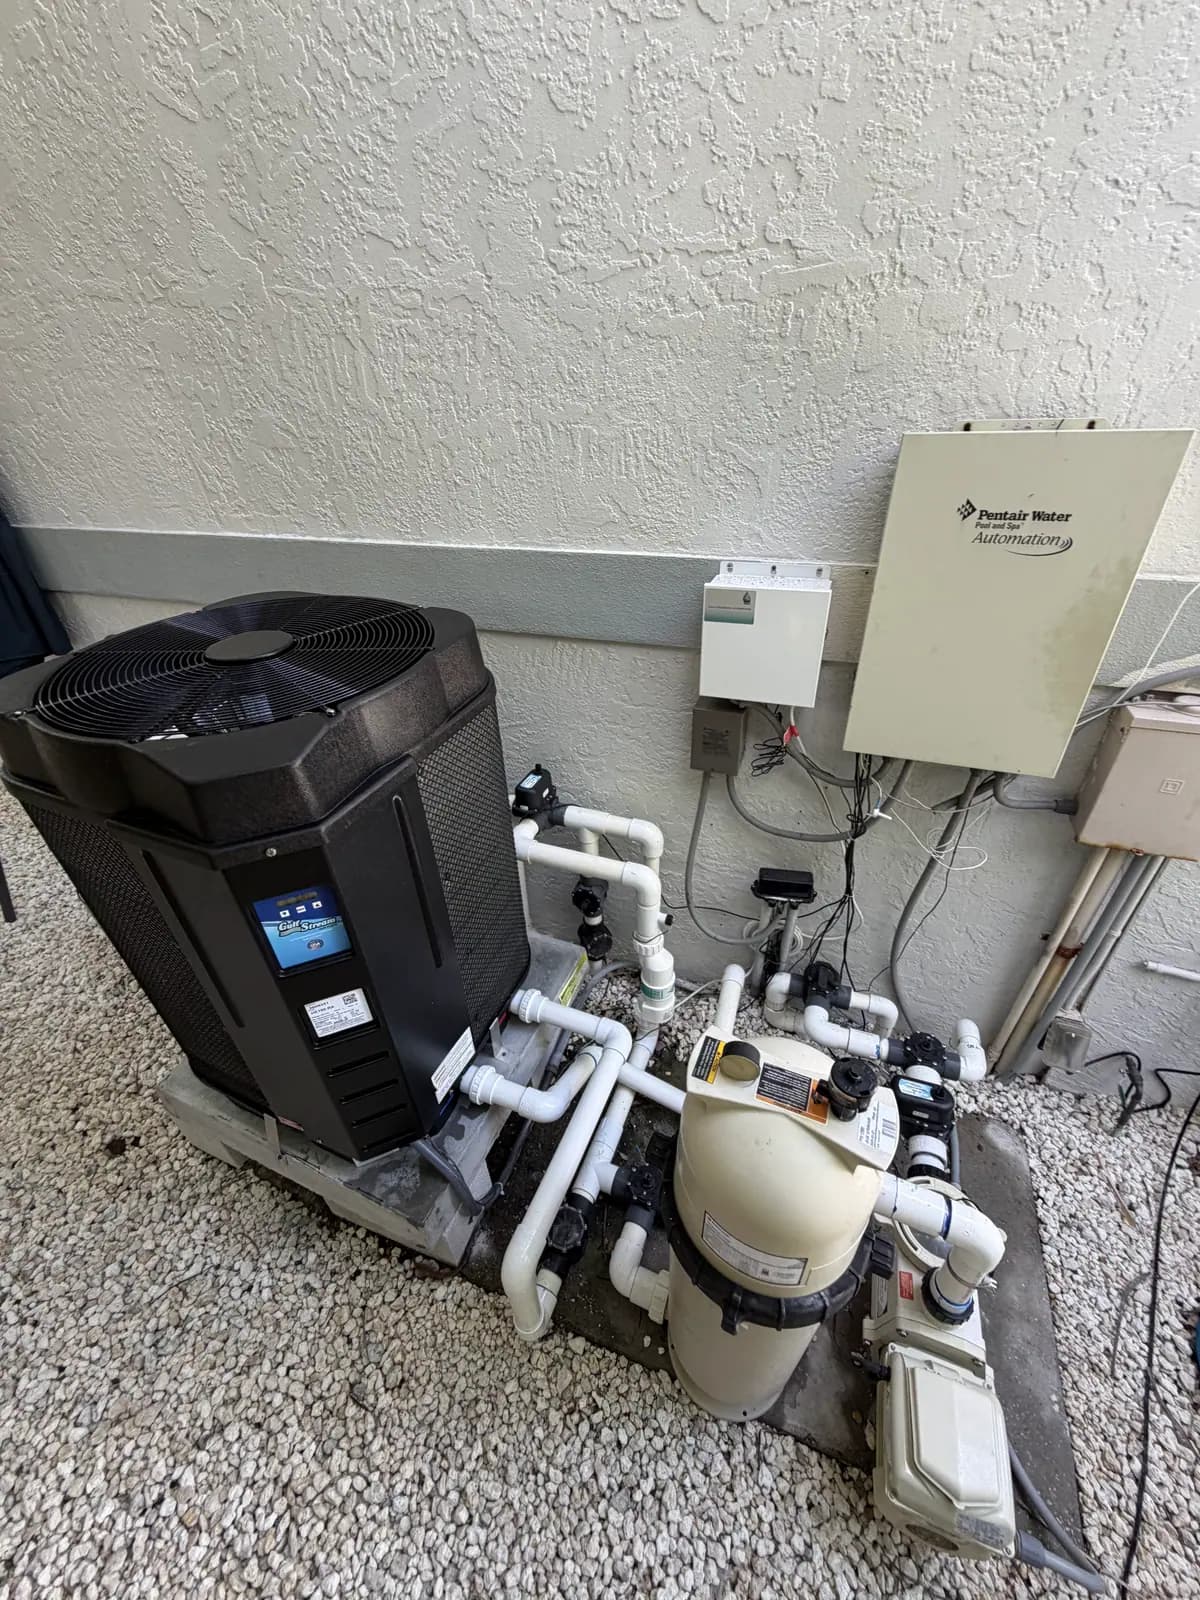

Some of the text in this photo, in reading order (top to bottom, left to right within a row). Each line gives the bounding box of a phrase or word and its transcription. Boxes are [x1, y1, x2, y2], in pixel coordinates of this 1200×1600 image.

[977, 509, 1072, 522] Pentair Water
[975, 521, 991, 529] Pool
[992, 522, 1005, 530] and
[972, 531, 1061, 546] Automation
[278, 917, 336, 932] Gulf Stream
